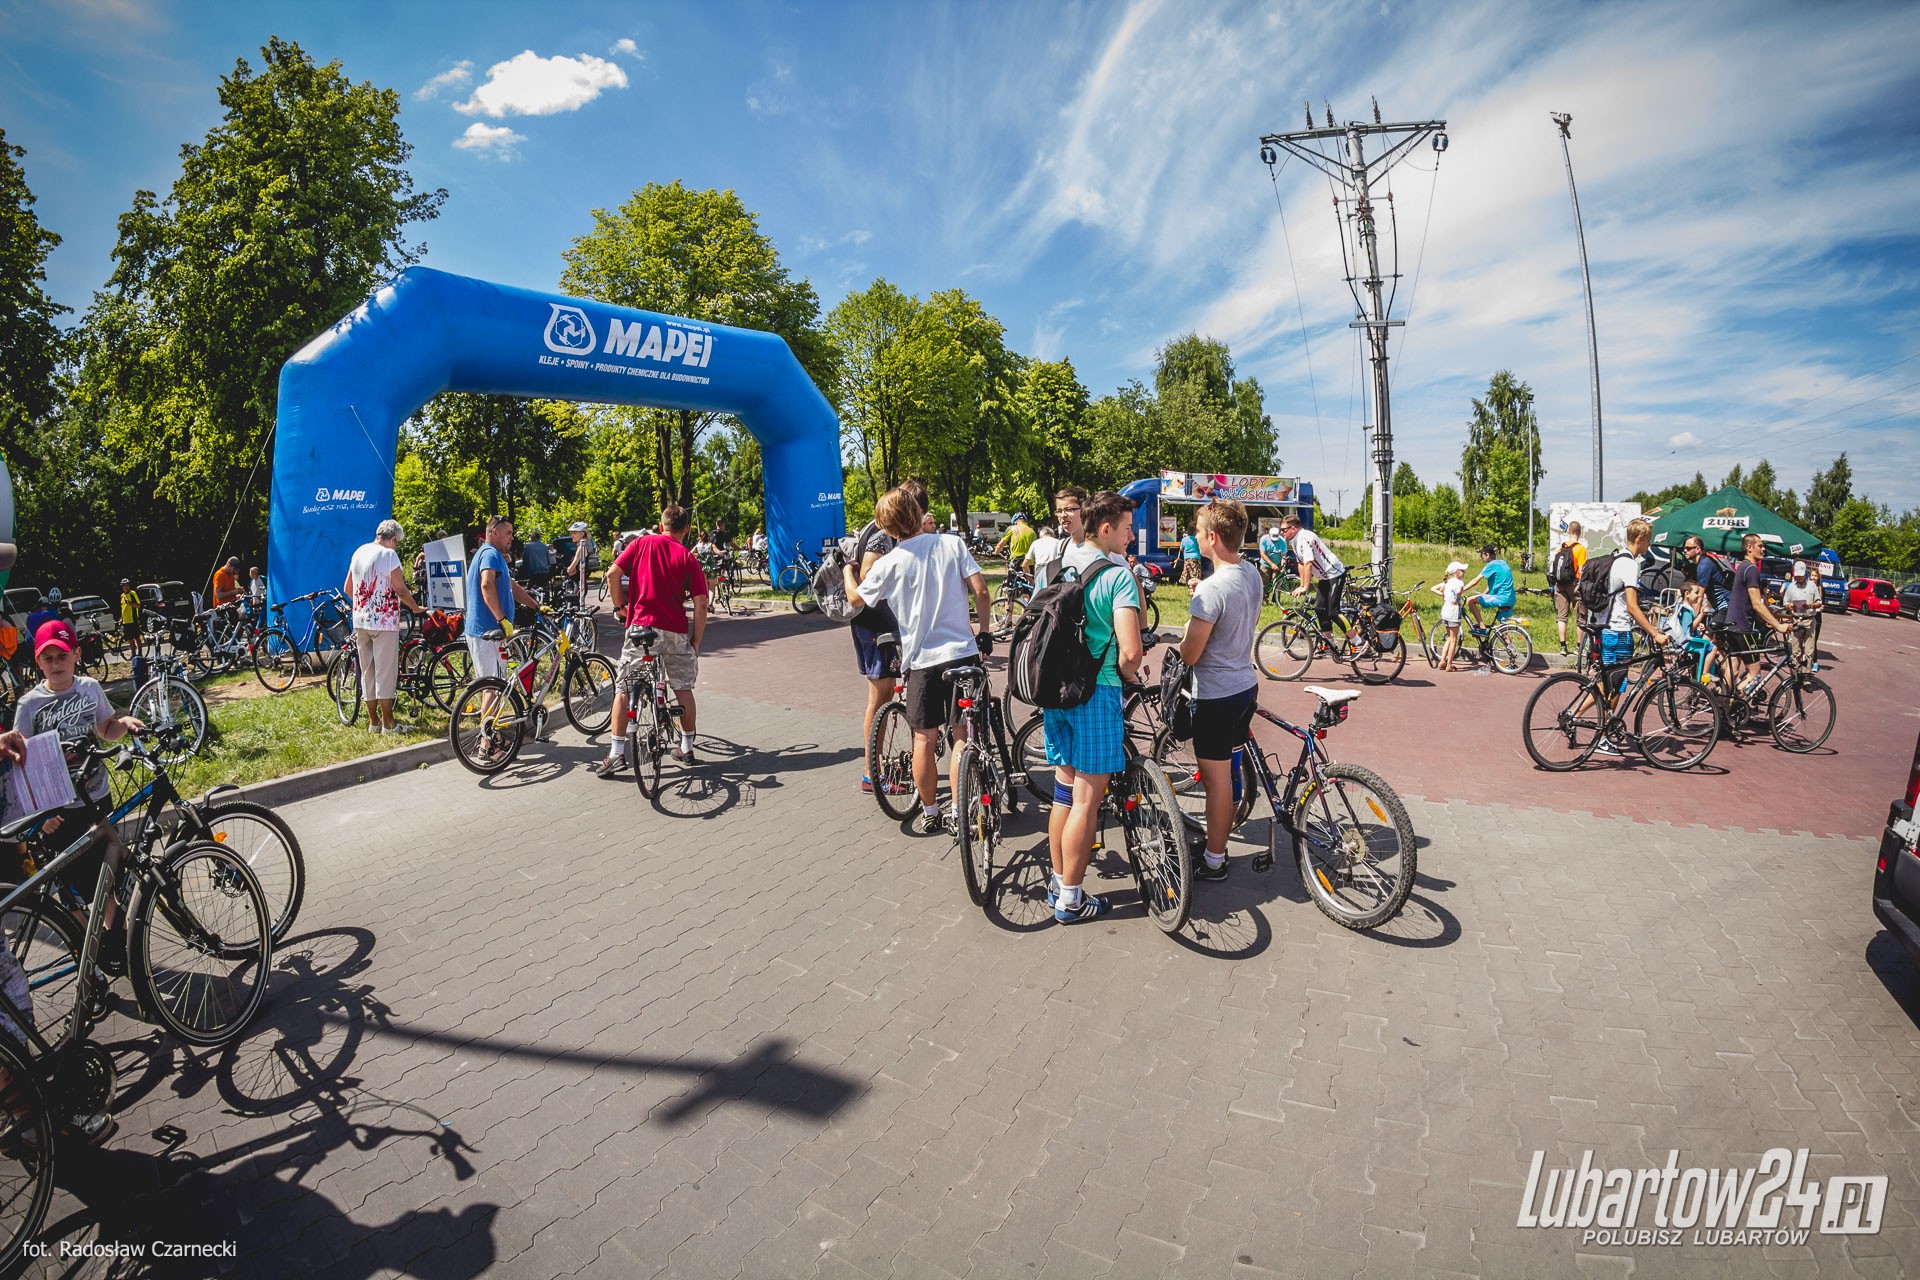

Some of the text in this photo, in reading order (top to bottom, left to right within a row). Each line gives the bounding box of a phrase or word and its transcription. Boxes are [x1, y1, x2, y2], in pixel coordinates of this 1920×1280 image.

[603, 318, 713, 368] MAPEI
[538, 355, 710, 385] KLEJE SPOINY PRODUKTY CHEMICZNE DLA BUDOWNICTWA
[1231, 477, 1269, 487] LODY
[331, 489, 366, 502] MAPEI
[1220, 488, 1276, 500] WŁOSKIE
[1707, 517, 1747, 527] ŻUBR
[38, 694, 98, 731] Vintage
